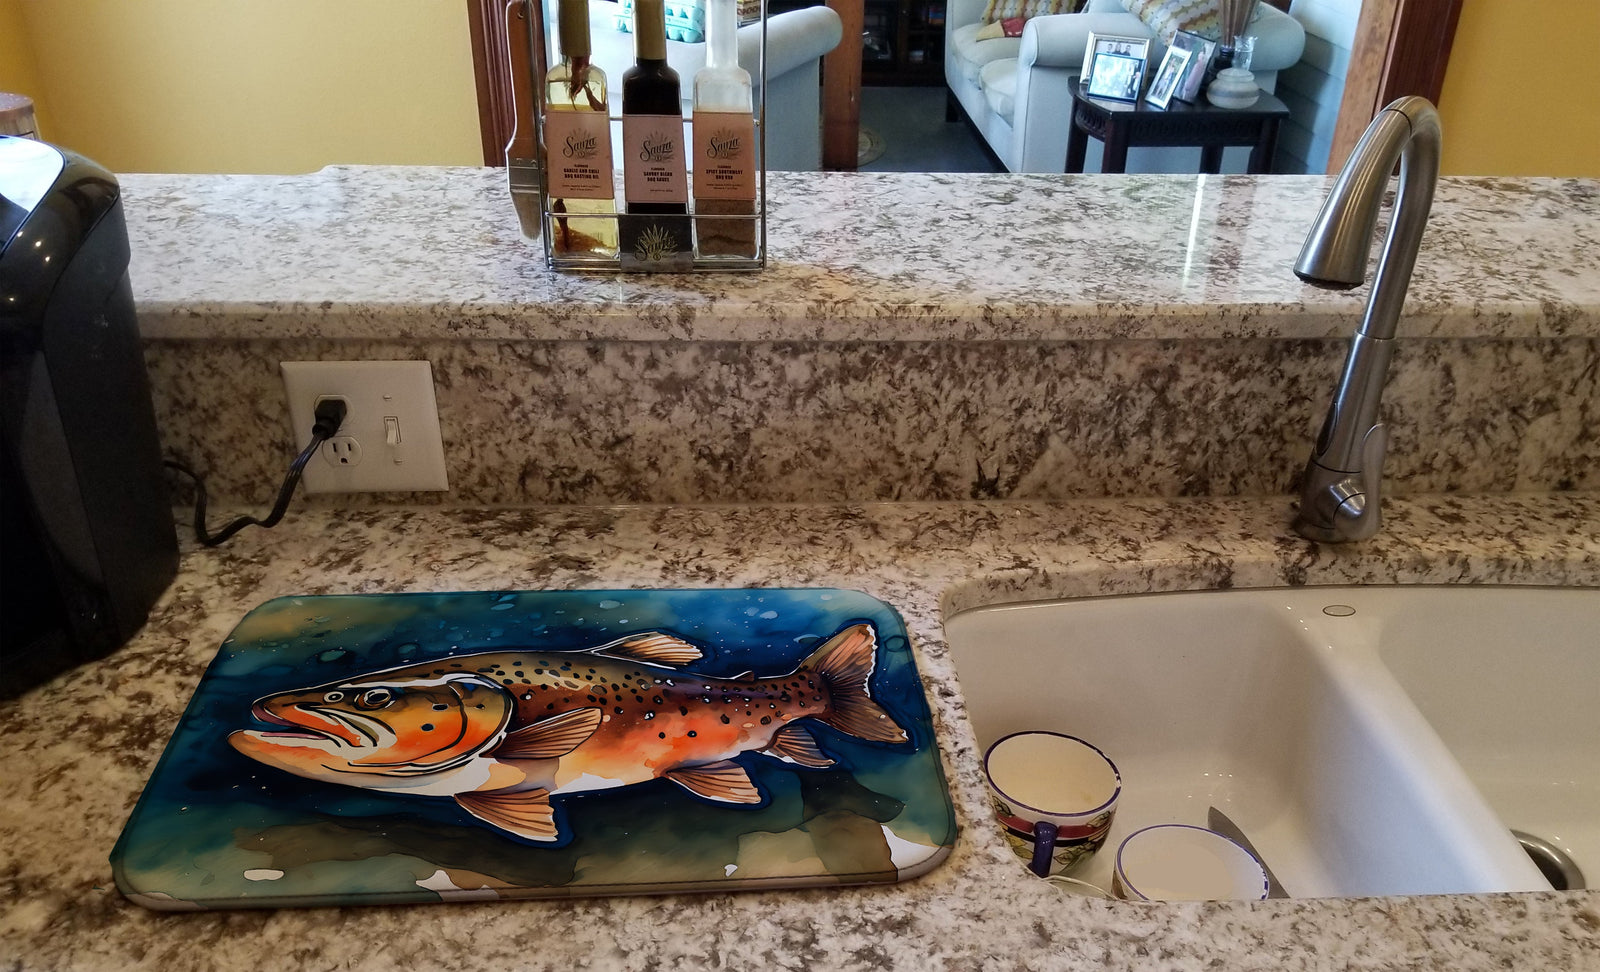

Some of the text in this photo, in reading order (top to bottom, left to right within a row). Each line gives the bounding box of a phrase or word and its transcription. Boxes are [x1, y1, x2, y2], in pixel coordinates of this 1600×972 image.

[563, 136, 596, 158] Sauza
[640, 140, 674, 162] Sauza
[707, 137, 739, 159] Sauza
